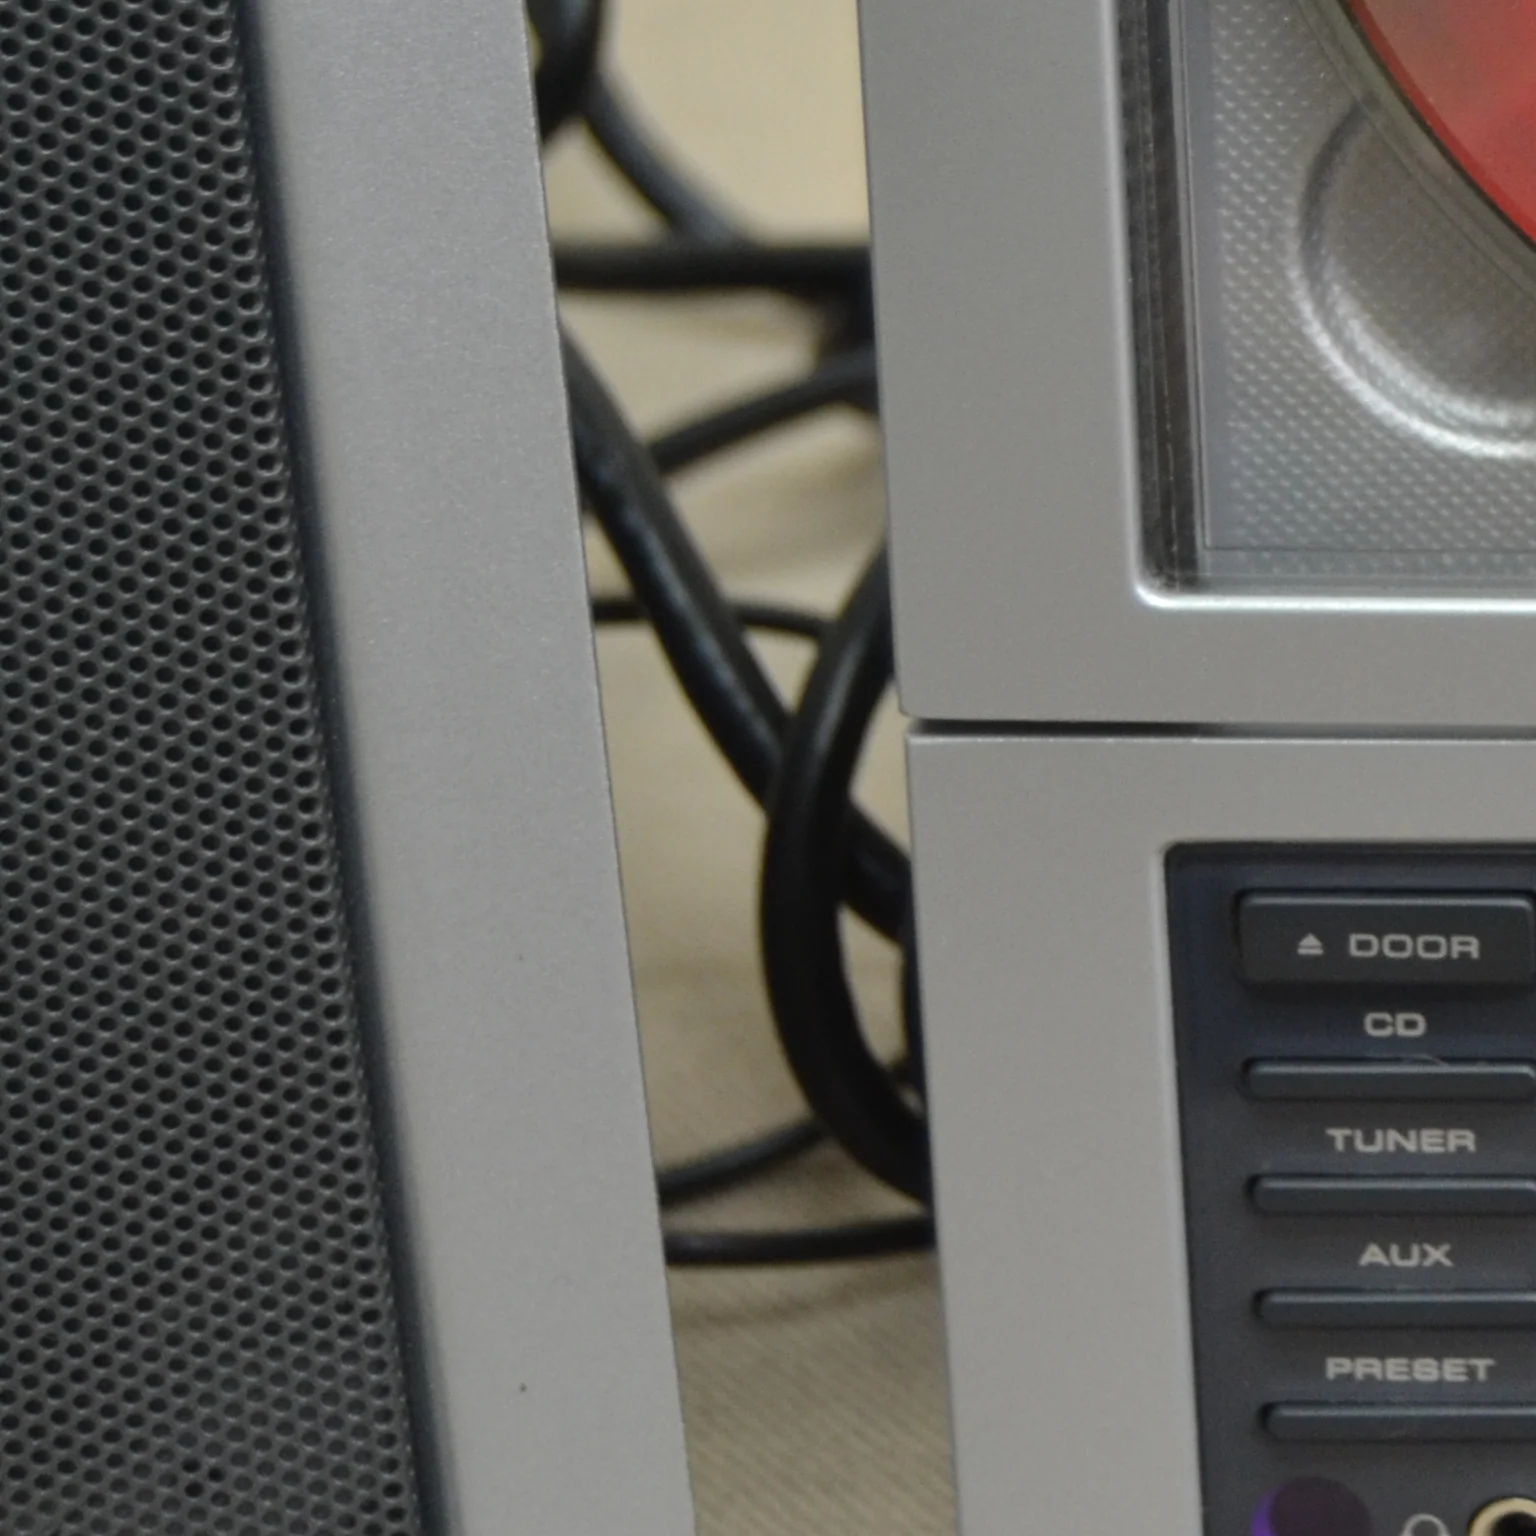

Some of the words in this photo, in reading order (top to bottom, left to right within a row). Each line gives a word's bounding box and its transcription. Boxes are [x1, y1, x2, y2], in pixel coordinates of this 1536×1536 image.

[1349, 934, 1481, 960] DOOR
[1363, 1012, 1427, 1038] CD
[1325, 1128, 1477, 1154] TUNER
[1358, 1243, 1453, 1267] AUX
[1325, 1357, 1496, 1382] PRESET
